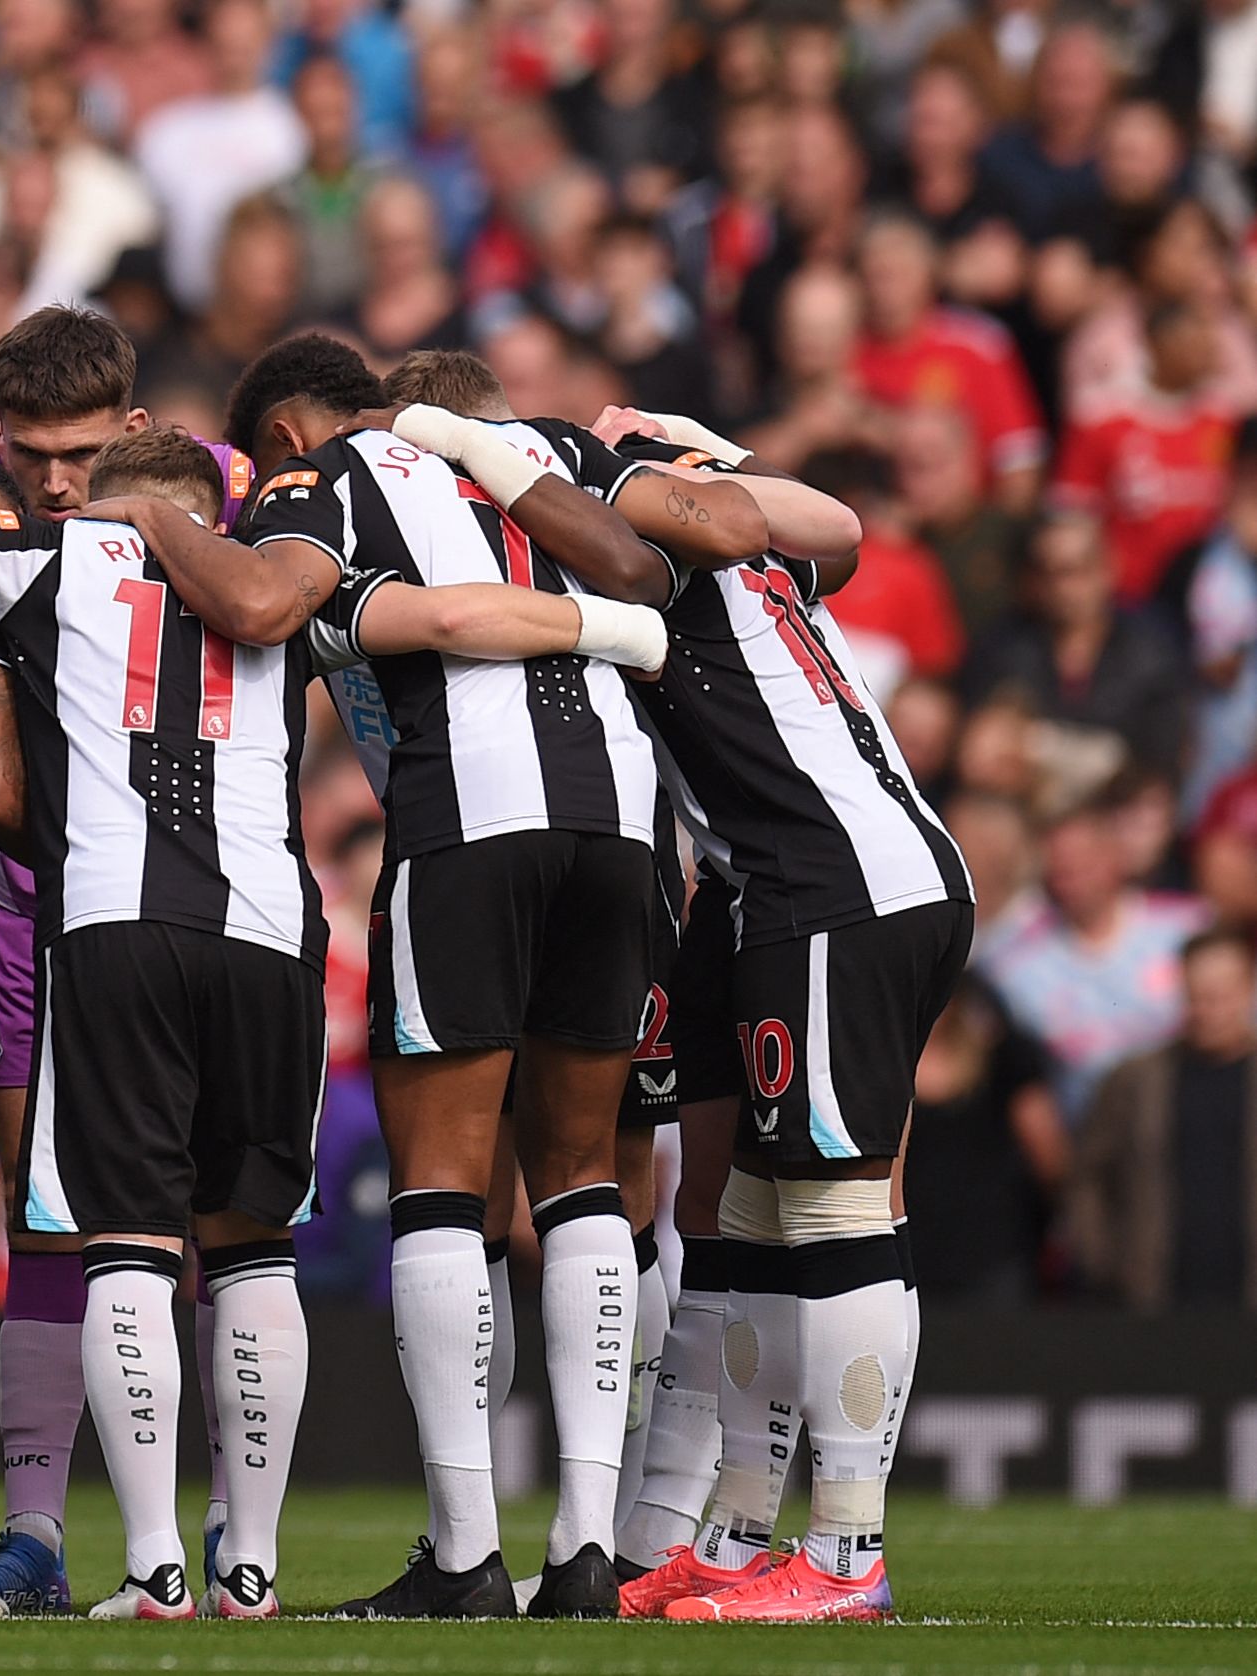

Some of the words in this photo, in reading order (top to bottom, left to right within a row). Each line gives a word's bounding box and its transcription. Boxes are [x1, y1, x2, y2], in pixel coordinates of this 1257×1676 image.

[112, 577, 236, 742] 11
[632, 982, 674, 1061] 2
[737, 1018, 794, 1100] 10
[112, 1303, 157, 1445] CASTORE
[474, 1288, 492, 1410] CASTORE
[595, 1266, 622, 1392] CASTORE
[232, 1328, 268, 1469] CASTORE
[704, 1525, 725, 1562] ESIGN
